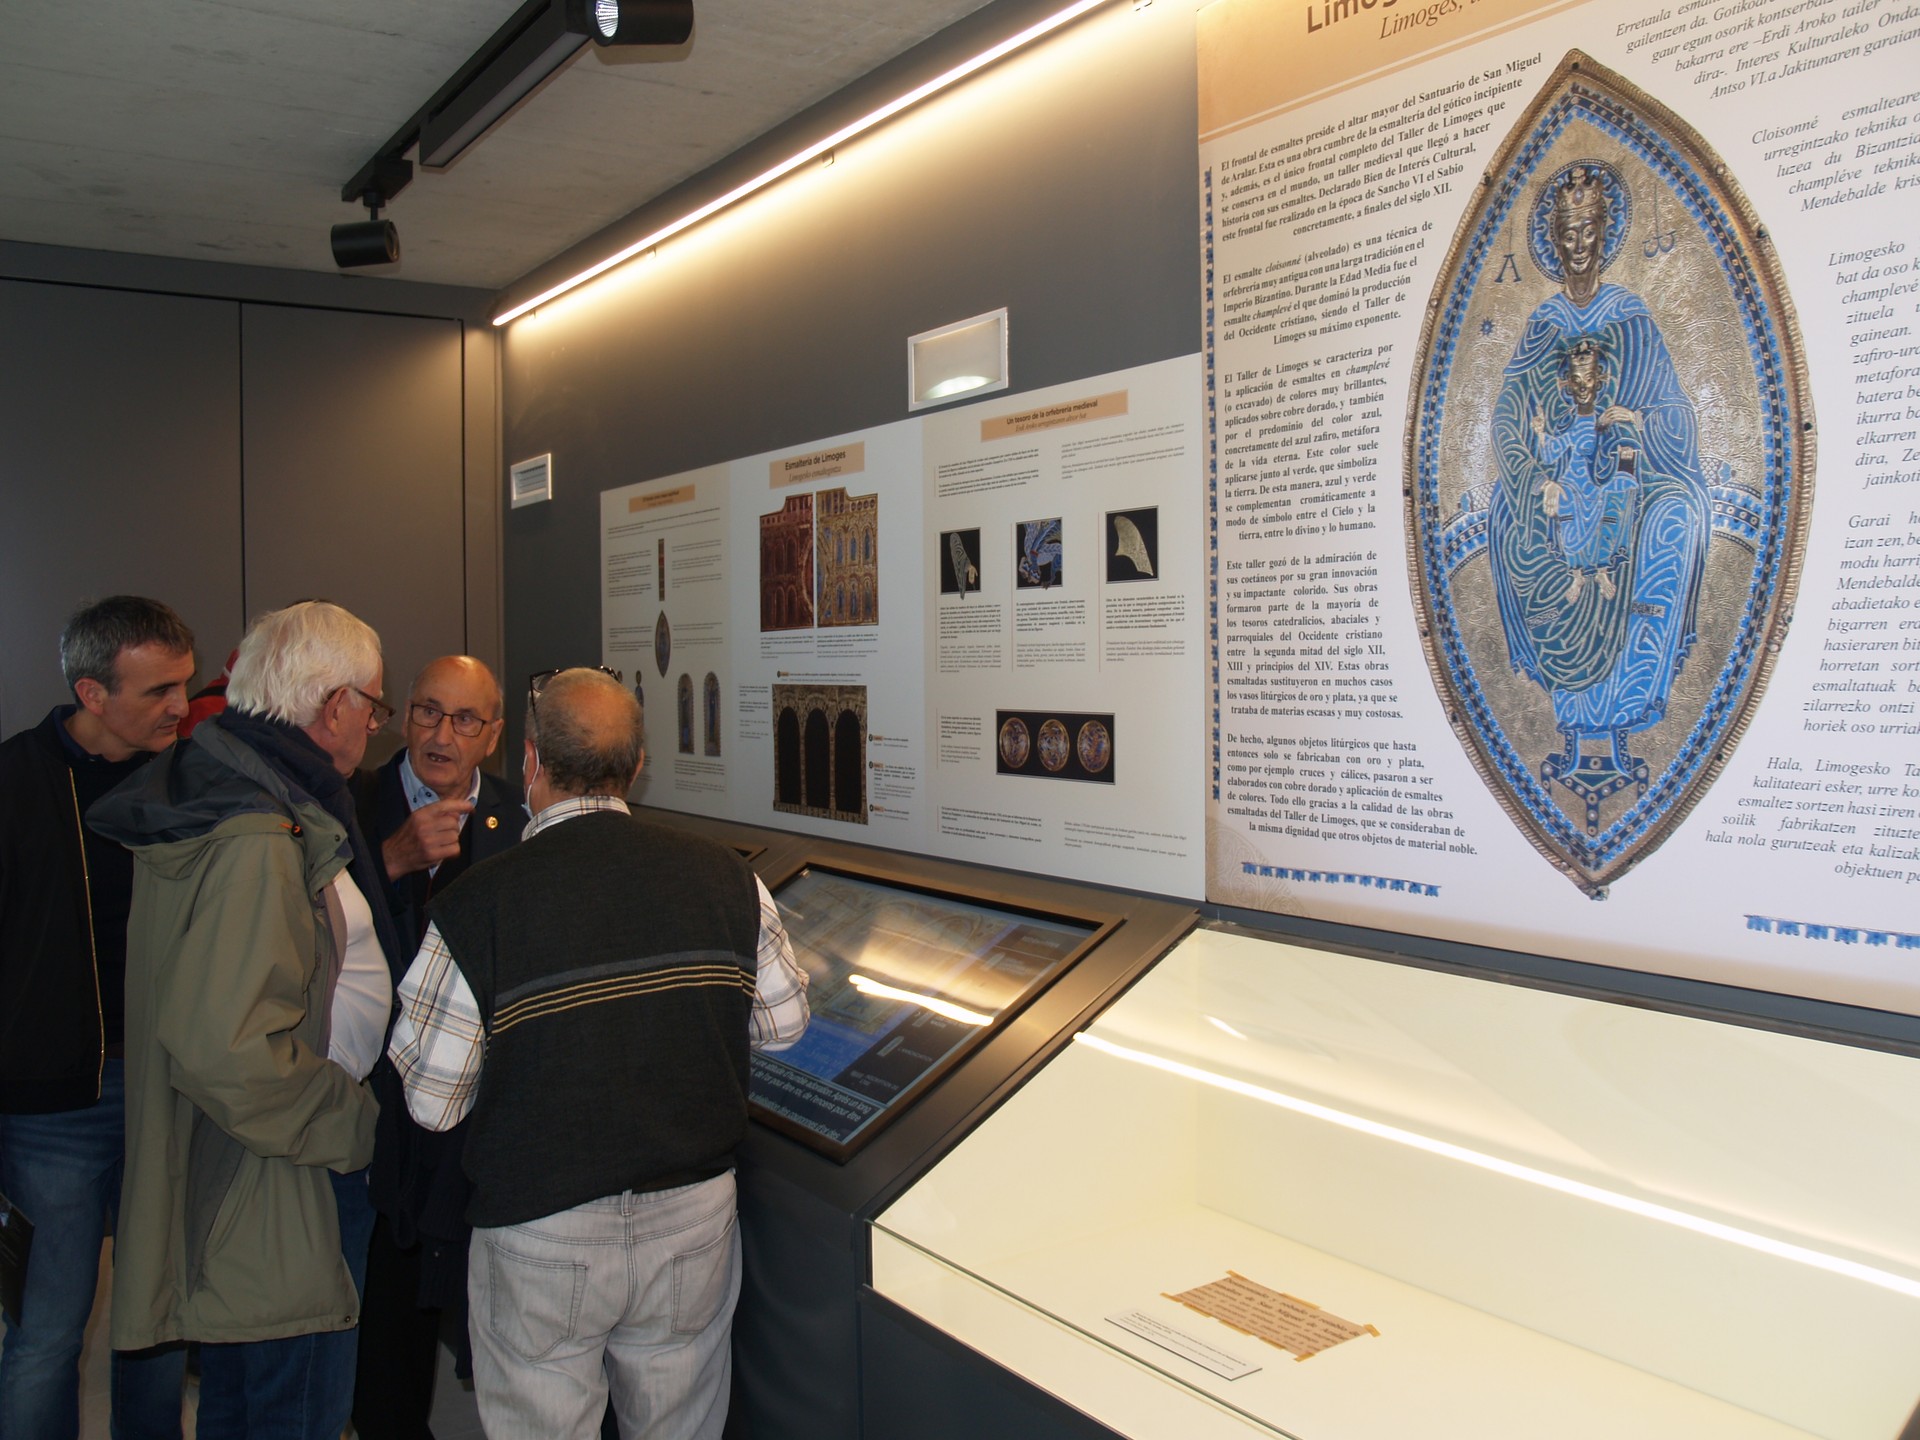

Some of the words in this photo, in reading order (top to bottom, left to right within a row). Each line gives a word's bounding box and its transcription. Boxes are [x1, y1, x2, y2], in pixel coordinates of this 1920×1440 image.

[1616, 9, 1670, 36] Erretaula
[1676, 49, 1724, 71] bakarra
[1729, 41, 1748, 54] ere
[1795, 12, 1836, 33] Aroko
[1736, 51, 1779, 72] Interes
[1788, 22, 1869, 56] Kulturaleko
[1878, 5, 1920, 27] Onda
[1710, 81, 1745, 99] Antso
[1779, 46, 1860, 78] Jakitunaren
[1222, 161, 1229, 171] El
[1232, 151, 1256, 167] frontal
[1259, 148, 1268, 158] de
[1271, 137, 1303, 154] esmaltes
[1306, 125, 1335, 144] preside
[1338, 120, 1344, 131] el
[1348, 114, 1368, 127] altar
[1372, 104, 1399, 119] mayor
[1402, 95, 1415, 108] del
[1419, 80, 1464, 103] Santuario
[1469, 75, 1479, 86] de
[1484, 69, 1501, 81] San
[1506, 52, 1541, 74] Miguel
[1752, 115, 1818, 144] Cloisonné
[1765, 130, 1848, 161] urregintzako
[1855, 115, 1907, 137] teknika
[1274, 172, 1280, 182] el
[1284, 167, 1305, 179] único
[1309, 154, 1335, 171] frontal
[1339, 143, 1377, 161] completo
[1381, 134, 1394, 147] del
[1398, 127, 1424, 141] Taller
[1428, 121, 1438, 132] de
[1444, 108, 1483, 127] Limoges
[1487, 101, 1505, 115] que
[1777, 161, 1811, 177] luzea
[1825, 151, 1841, 165] du
[1801, 181, 1886, 211] Mendebalde
[1224, 274, 1231, 284] El
[1234, 267, 1262, 281] esmalte
[1266, 255, 1301, 273] cloisonné
[1305, 242, 1349, 263] (alveolado)
[1353, 241, 1361, 249] es
[1366, 235, 1382, 246] una
[1387, 226, 1417, 240] técnica
[1422, 221, 1432, 231] de
[1829, 241, 1904, 266] Limogesko
[1842, 282, 1919, 304] champlevé
[1274, 331, 1306, 344] Limoges
[1308, 329, 1317, 337] su
[1320, 321, 1352, 334] máximo
[1225, 374, 1232, 383] El
[1237, 370, 1258, 381] Taller
[1262, 367, 1271, 376] de
[1276, 361, 1308, 373] Limoges
[1314, 358, 1321, 366] se
[1326, 348, 1372, 363] caracteriza
[1378, 344, 1393, 356] por
[1073, 400, 1098, 411] medieval
[1857, 431, 1916, 445] elkarren
[822, 451, 846, 462] Limoges
[1237, 499, 1291, 512] complementan
[1300, 490, 1365, 504] cromáticamente
[1227, 560, 1242, 569] Este
[1246, 559, 1265, 568] taller
[1269, 556, 1286, 569] gozó
[1291, 556, 1300, 565] de
[1304, 555, 1311, 564] la
[1315, 551, 1362, 564] admiración
[1367, 550, 1376, 560] de
[1832, 595, 1910, 610] abadietako
[1227, 632, 1273, 644] parroquiales
[1280, 631, 1291, 641] del
[1299, 631, 1338, 640] Occidente
[1346, 629, 1382, 639] cristiano
[1828, 618, 1887, 634] bigarren
[1824, 638, 1898, 651] hasieraren
[1227, 676, 1267, 685] esmaltadas
[1271, 676, 1318, 688] sustituyeron
[1335, 676, 1366, 686] muchos
[1812, 678, 1896, 692] esmaltatuak
[1803, 698, 1871, 712] zilarrezko
[1880, 703, 1914, 713] ontzi
[1228, 733, 1237, 742] De
[1267, 735, 1296, 747] algunos
[1299, 737, 1327, 749] objetos
[1331, 738, 1369, 750] litúrgicos
[1373, 742, 1389, 752] que
[1393, 740, 1416, 751] hasta
[1816, 759, 1890, 777] Limogesko
[1753, 775, 1820, 791] kalitateari
[1868, 786, 1898, 796] urre
[1722, 813, 1756, 826] soilik
[1778, 816, 1855, 833] fabrikatzen
[1250, 821, 1256, 830] la
[1258, 823, 1282, 833] misma
[1285, 825, 1319, 837] dignidad
[1322, 831, 1336, 841] que
[1339, 832, 1359, 841] otros
[1362, 833, 1392, 845] objetos
[1395, 836, 1405, 846] de
[1408, 840, 1446, 851] material
[1706, 830, 1732, 843] hala
[1738, 833, 1766, 846] nola
[1770, 839, 1836, 854] gurutzeak
[1842, 845, 1863, 855] eta
[1835, 861, 1902, 879] objektuen
